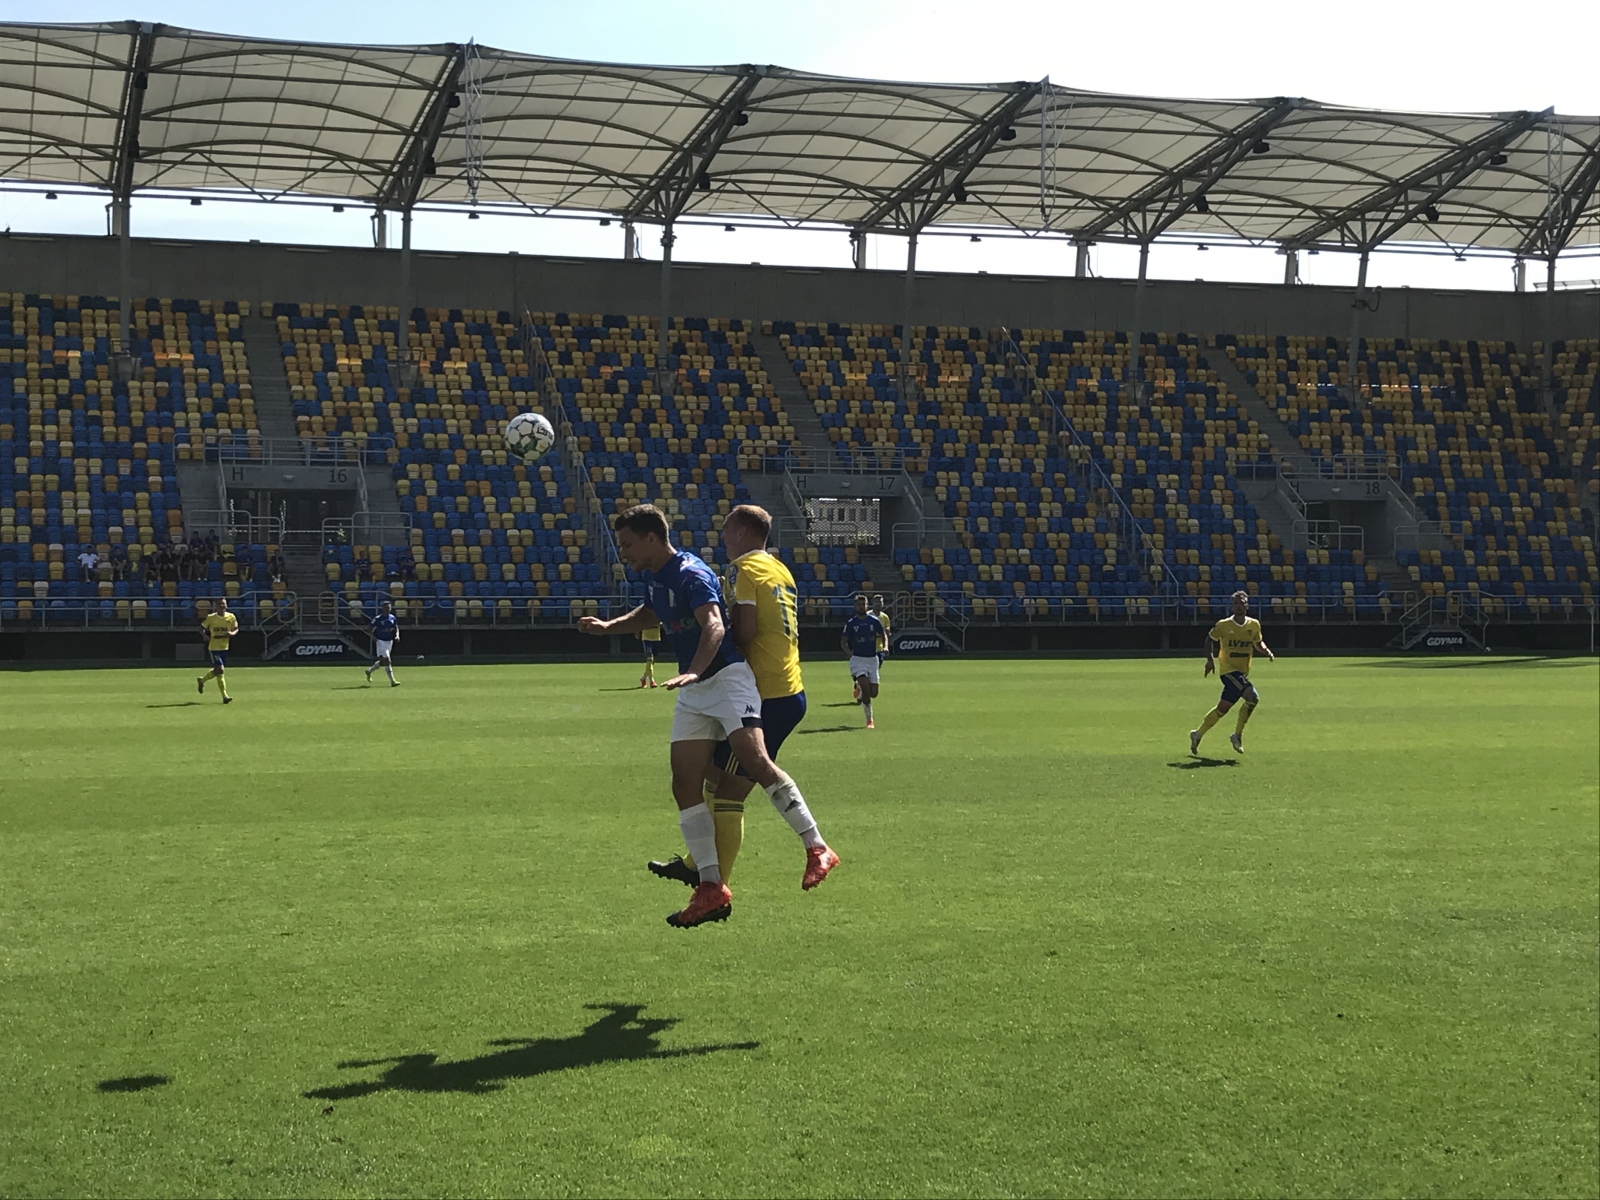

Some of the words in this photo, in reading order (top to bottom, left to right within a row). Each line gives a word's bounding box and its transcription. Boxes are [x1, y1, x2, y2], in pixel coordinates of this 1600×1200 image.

[232, 466, 243, 481] H
[328, 468, 348, 483] 16
[797, 475, 807, 489] H
[879, 476, 895, 490] 17
[1365, 481, 1380, 495] 18
[899, 640, 940, 650] GDYNIA
[1426, 636, 1463, 647] GDYNIA
[295, 644, 343, 656] GDYNIA
